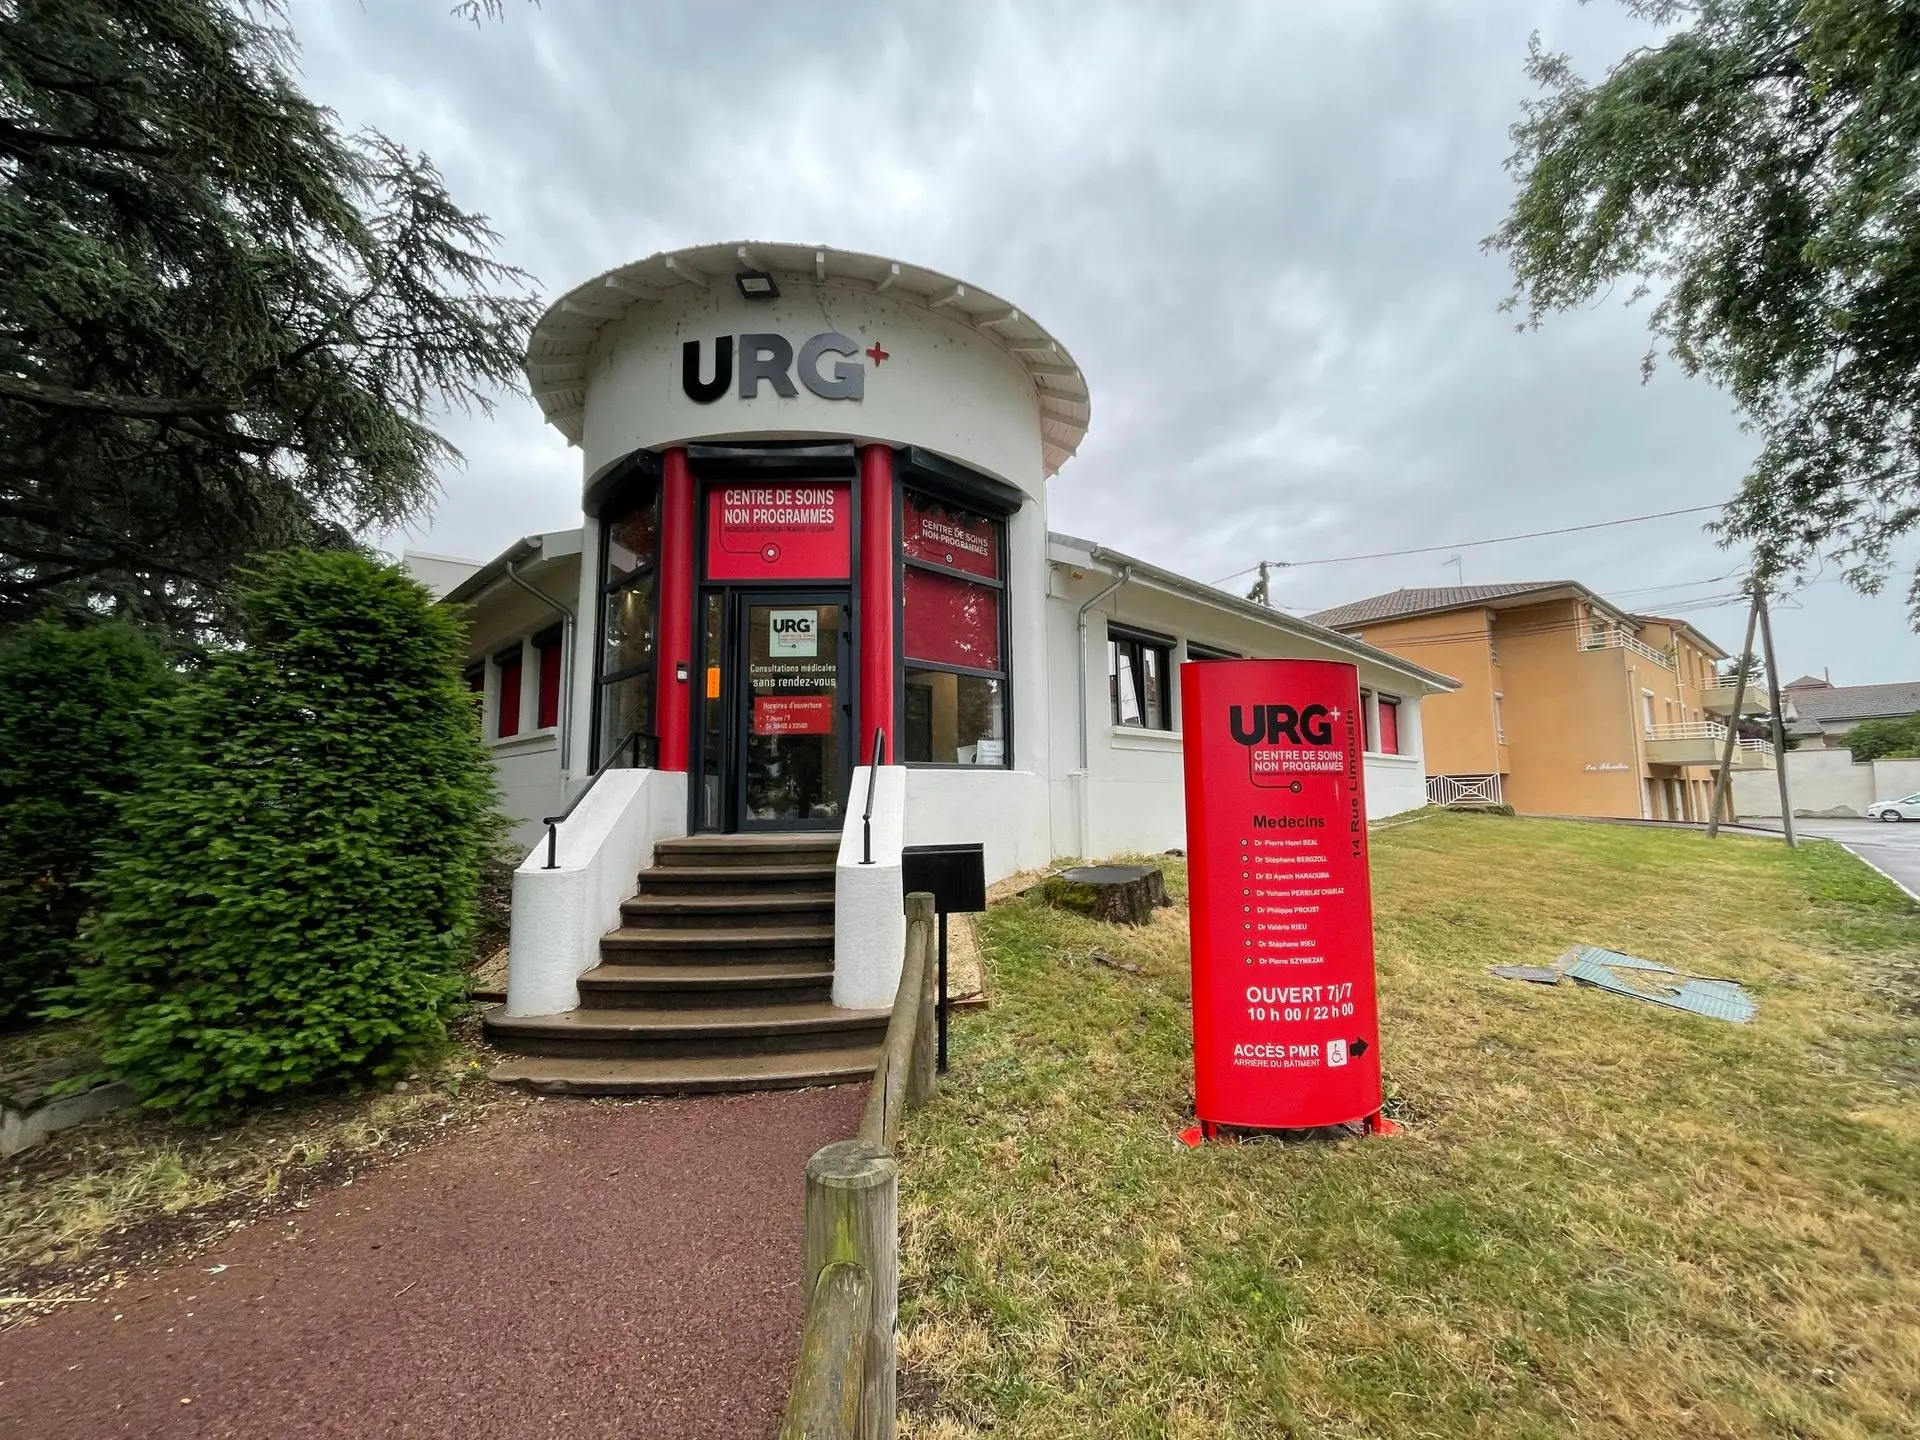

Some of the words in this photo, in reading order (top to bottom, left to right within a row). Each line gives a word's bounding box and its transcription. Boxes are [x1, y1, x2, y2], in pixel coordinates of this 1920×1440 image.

[724, 489, 773, 506] CENTRE
[776, 489, 793, 506] DE
[795, 488, 835, 506] SOINS
[724, 508, 750, 524] NON
[753, 505, 835, 524] PROGRAMMÉS
[922, 519, 953, 536] CENTRE
[954, 527, 965, 540] DE
[965, 533, 989, 547] SOINS
[922, 528, 989, 556] NON-PROGRAMMÉS
[750, 663, 799, 673] Consultations
[800, 662, 837, 673] médicales
[753, 678, 776, 688] sans
[778, 675, 836, 688] rendez-vous
[1254, 750, 1300, 760] CENTRE
[1302, 750, 1316, 760] DE
[1317, 750, 1344, 760] SOINS
[1345, 710, 1358, 791] Limousin
[1254, 761, 1279, 771] NON
[1282, 760, 1344, 771] PROGRAMMÉS
[1253, 815, 1325, 828] Medecins
[1350, 798, 1360, 833] Rue
[1352, 839, 1361, 859] 14
[1264, 856, 1295, 864] Stéphane
[1273, 873, 1294, 881] Ayech
[1266, 906, 1293, 914] Philippe
[1267, 940, 1299, 948] Stéphane
[1269, 957, 1289, 965] Pierre
[1246, 985, 1323, 1003] OUVERT
[1327, 982, 1353, 1004] 7j/7
[1248, 1007, 1266, 1021] 10
[1270, 1007, 1279, 1021] h
[1284, 1007, 1302, 1021] 00
[1305, 1007, 1310, 1021] /
[1314, 1006, 1329, 1020] 22
[1332, 1004, 1339, 1018] h
[1341, 1002, 1354, 1016] 00
[1233, 1042, 1285, 1058] ACCÈS
[1289, 1044, 1319, 1057] PMR
[1270, 1060, 1282, 1068] DU
[1283, 1058, 1321, 1068] BÂTIMENT
